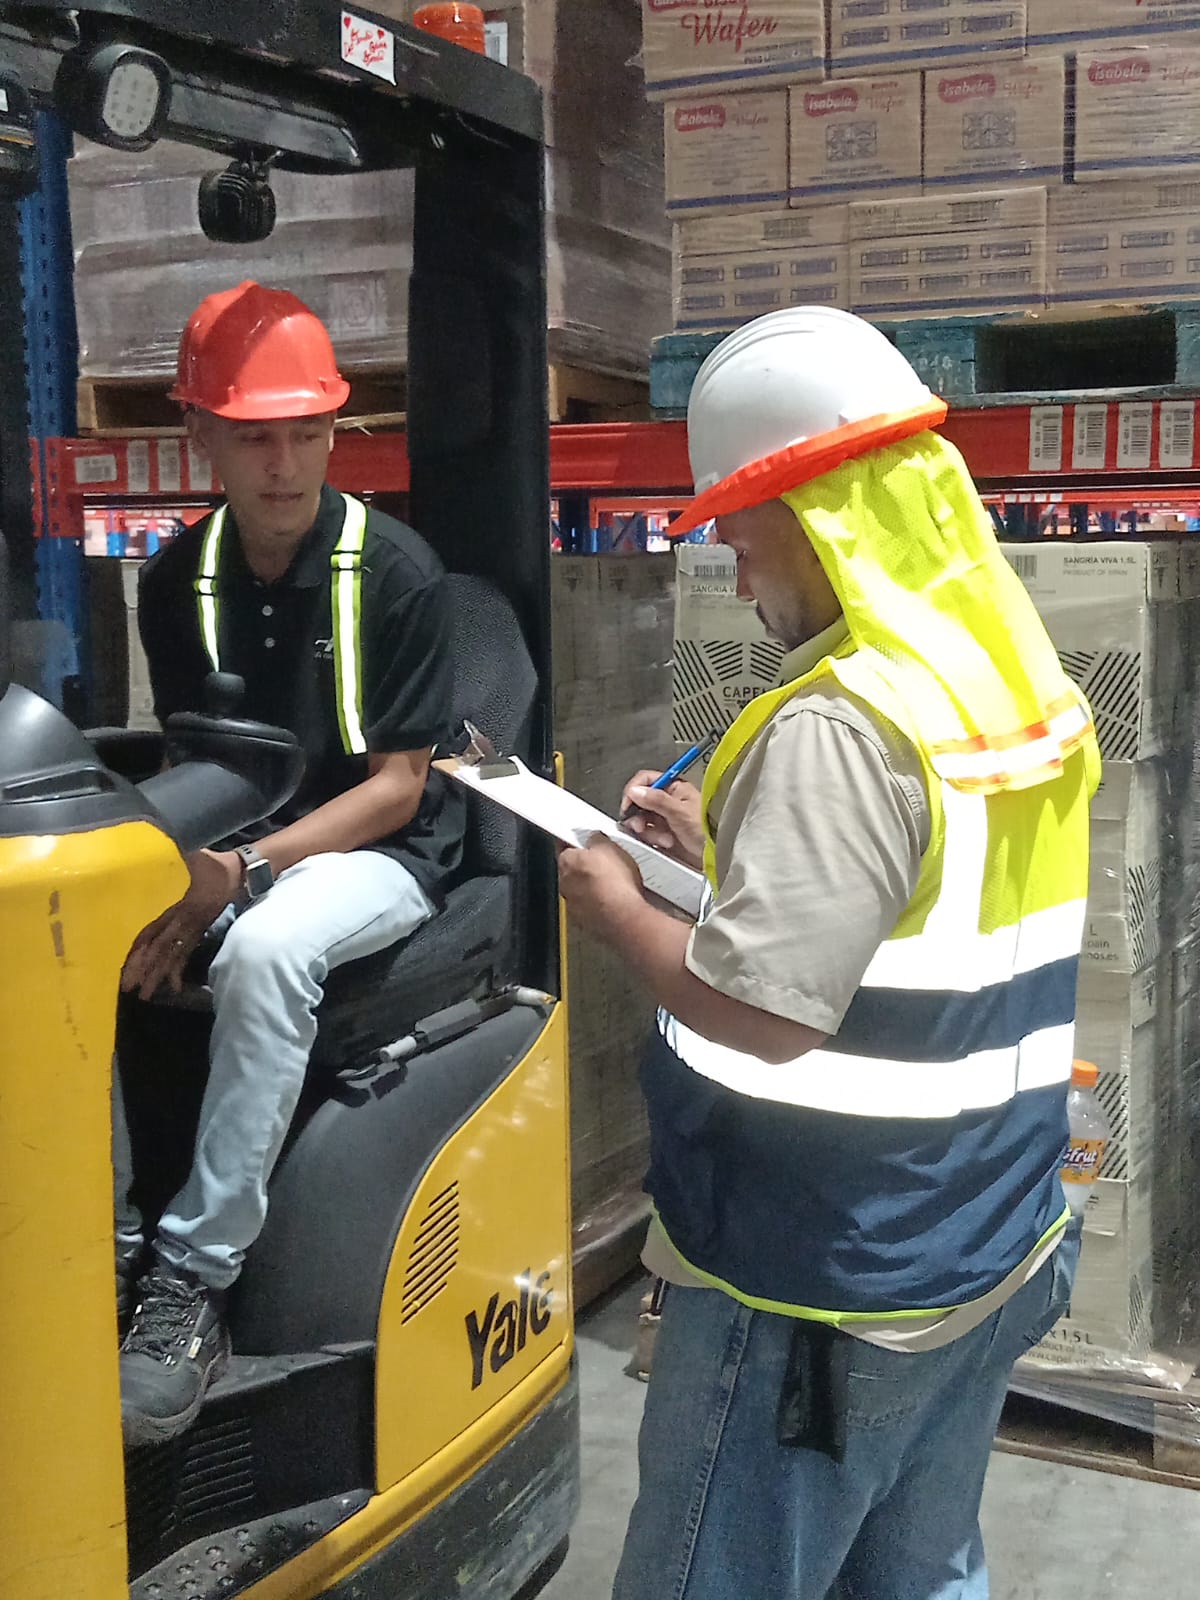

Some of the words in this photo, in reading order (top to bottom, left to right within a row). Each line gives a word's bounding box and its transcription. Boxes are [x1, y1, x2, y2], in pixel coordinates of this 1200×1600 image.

[681, 4, 779, 52] Wafer
[1100, 556, 1118, 564] VIVA
[465, 1267, 554, 1391] Yale
